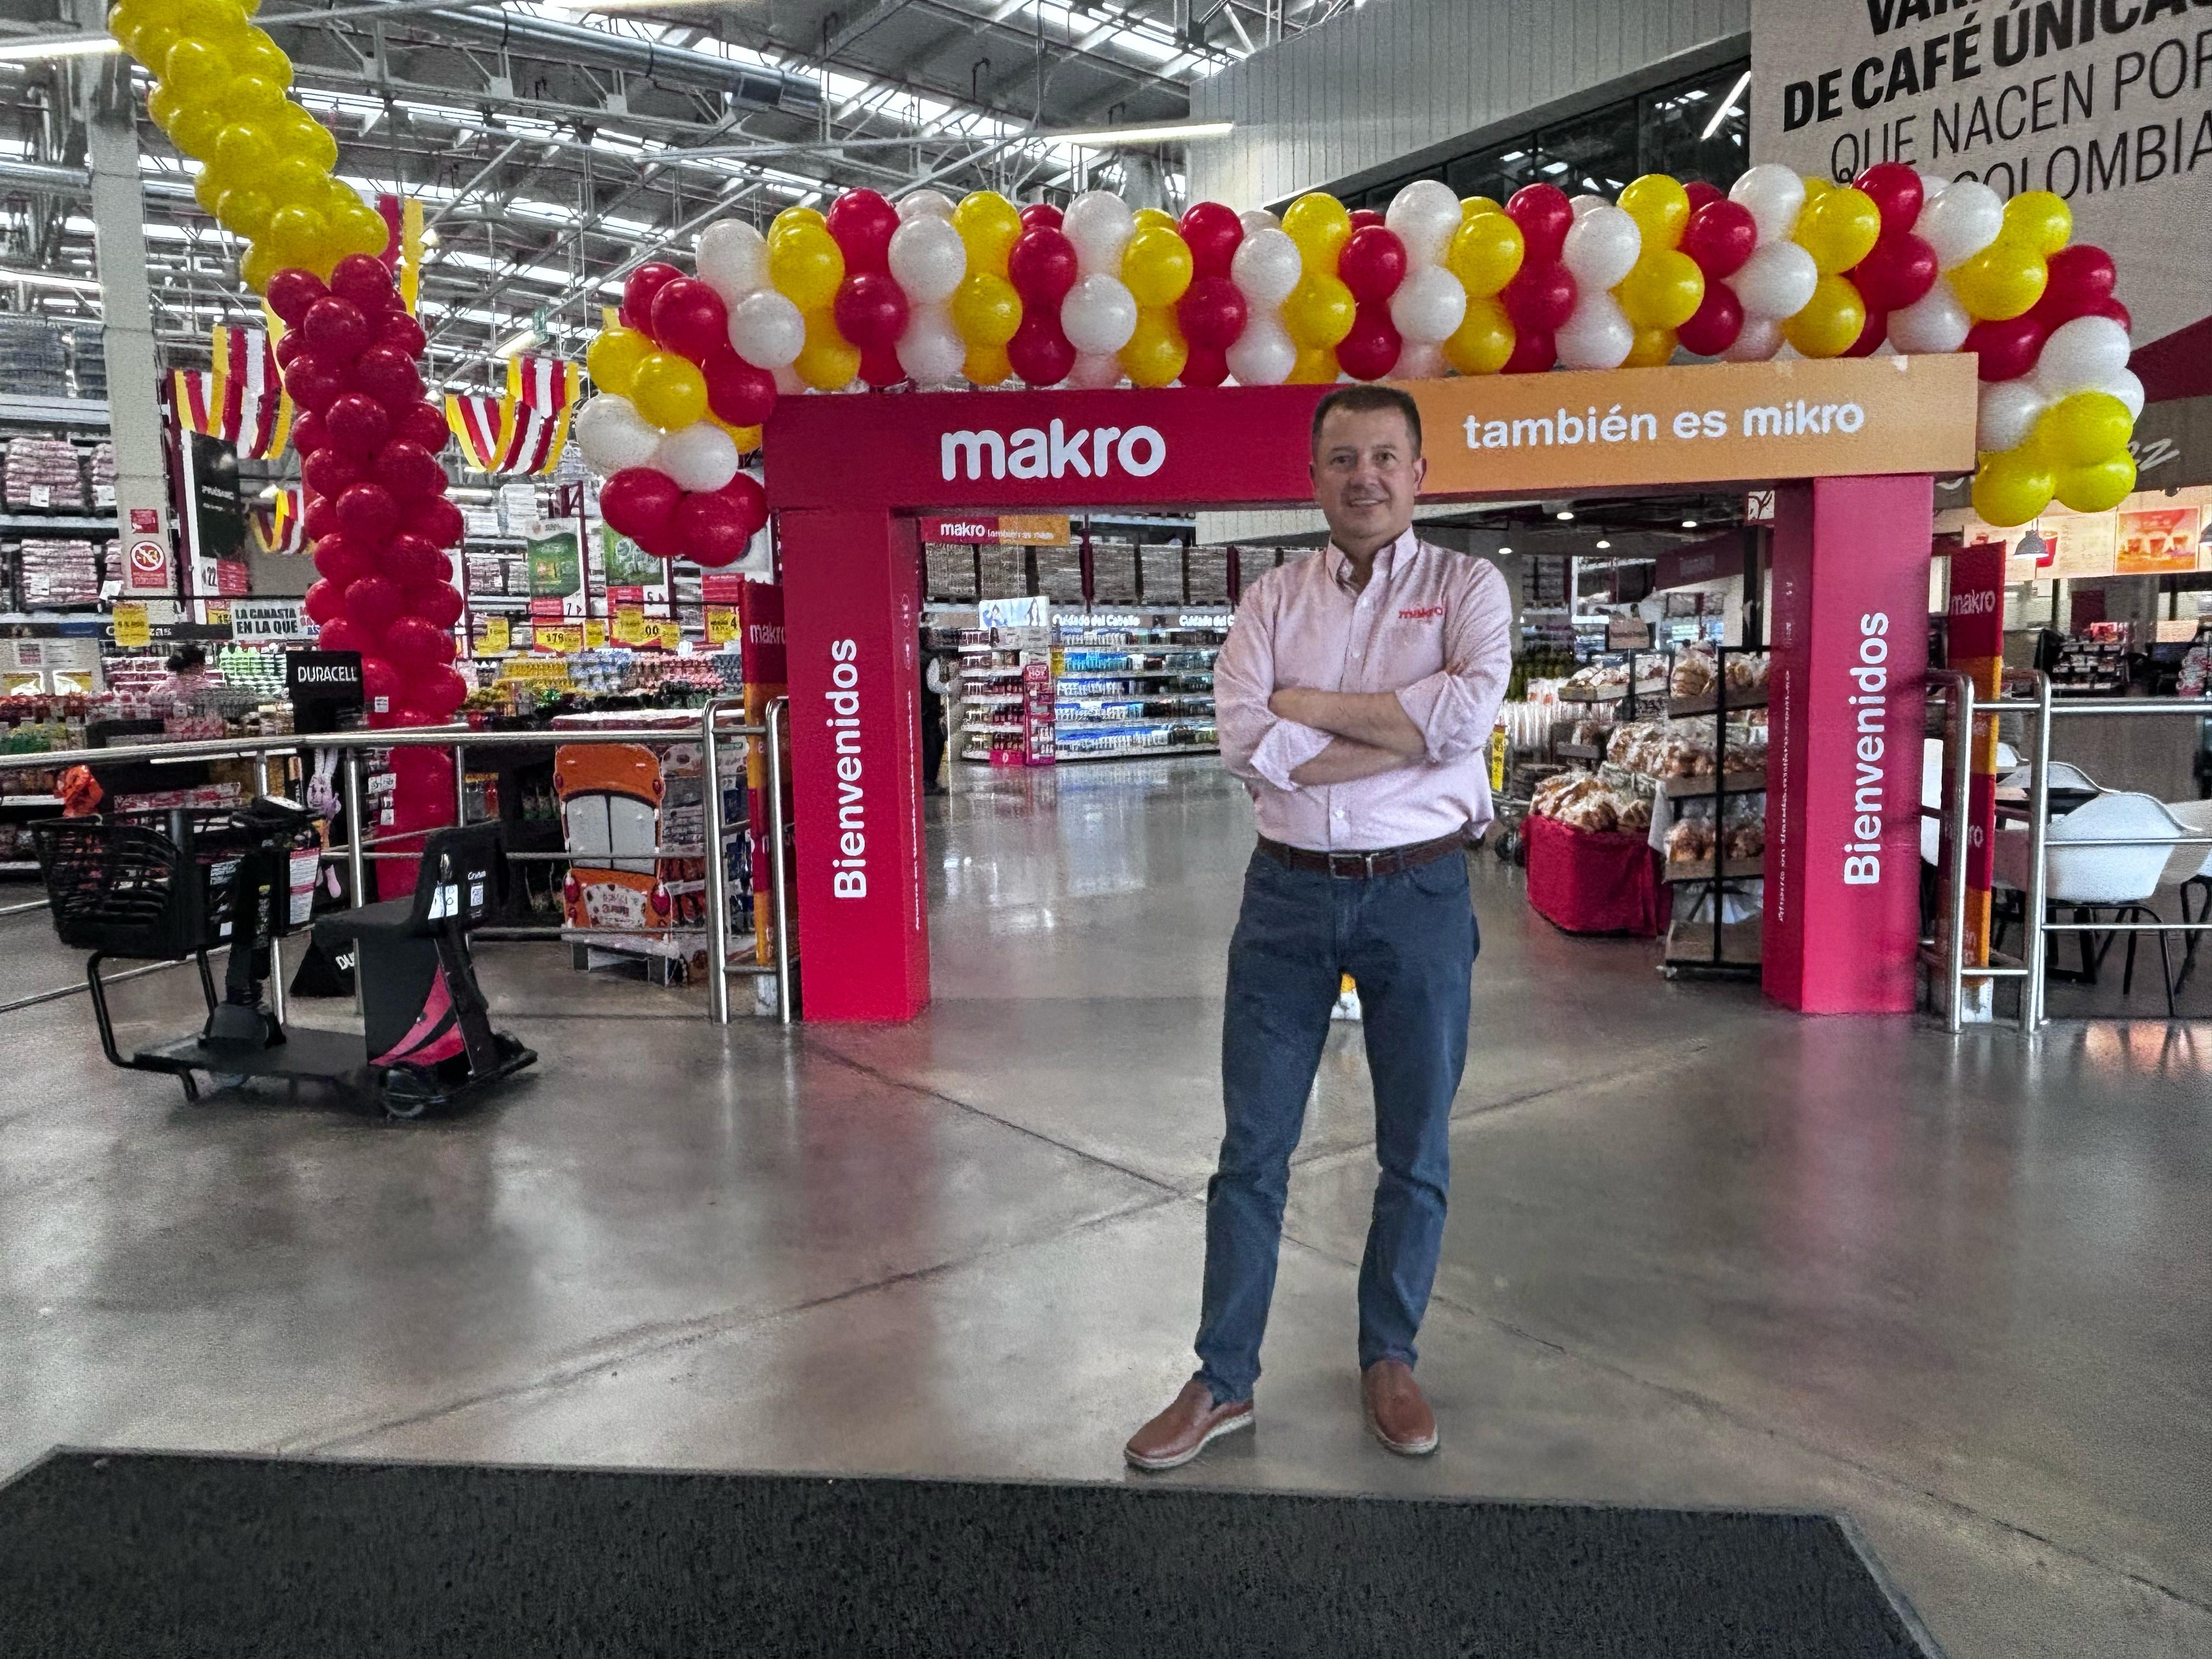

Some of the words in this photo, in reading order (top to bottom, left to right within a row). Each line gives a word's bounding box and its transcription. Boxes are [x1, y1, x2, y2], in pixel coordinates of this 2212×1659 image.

[1784, 67, 1843, 133] DE
[1852, 10, 1982, 110] CAFÉ
[1831, 115, 1917, 184] QUE
[1932, 64, 2094, 159] NACEN
[1953, 110, 2212, 201] OLOMBIA
[941, 418, 1166, 481] makro
[1463, 404, 1657, 449] también
[1672, 408, 1727, 439] es
[1743, 399, 1864, 437] mikro
[941, 522, 986, 537] makro
[235, 609, 247, 619] LA
[236, 620, 252, 634] EN
[256, 620, 271, 634] LA
[273, 619, 298, 634] QUE
[1951, 589, 1996, 615] makro
[297, 665, 358, 682] DURACELL
[825, 639, 866, 898] Bienvenidos
[1844, 612, 1889, 884] Bienvenidos
